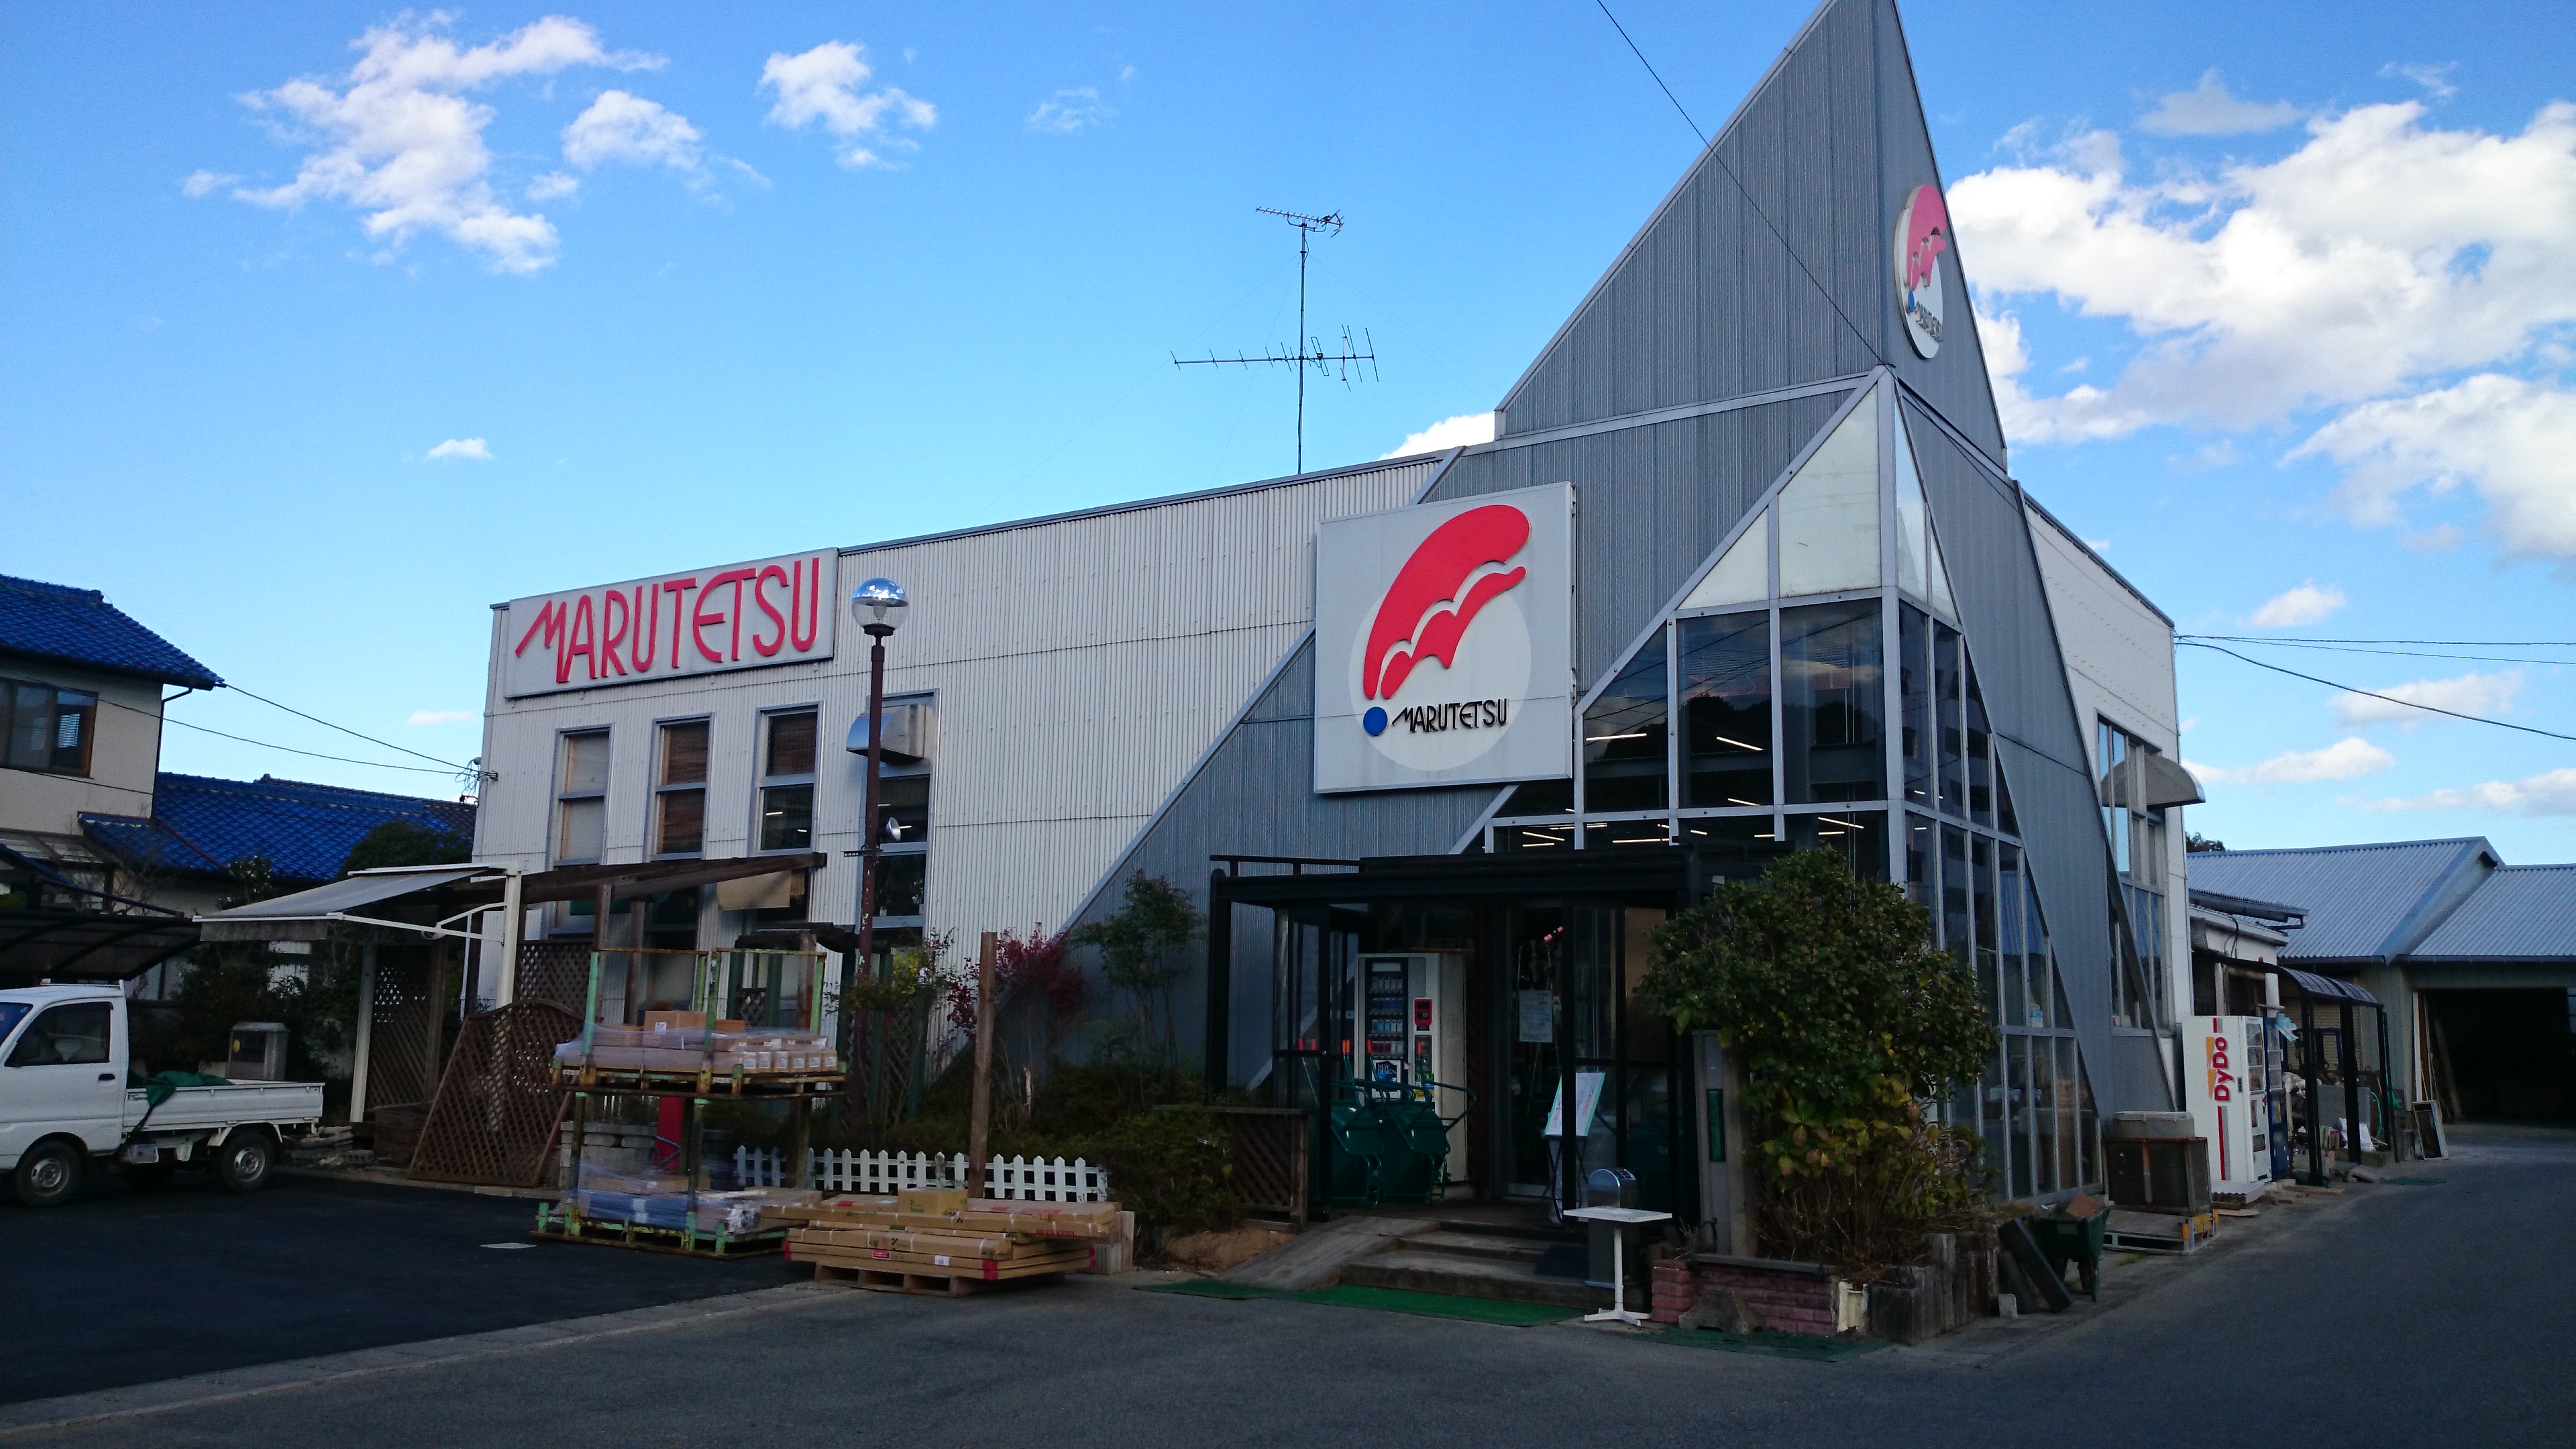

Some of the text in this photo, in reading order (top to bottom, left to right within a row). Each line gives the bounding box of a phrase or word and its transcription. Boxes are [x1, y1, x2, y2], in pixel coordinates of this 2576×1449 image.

[515, 557, 819, 683] MARUTETSU
[1392, 698, 1507, 733] MARUTETSU
[2212, 1037, 2234, 1100] DyDo
